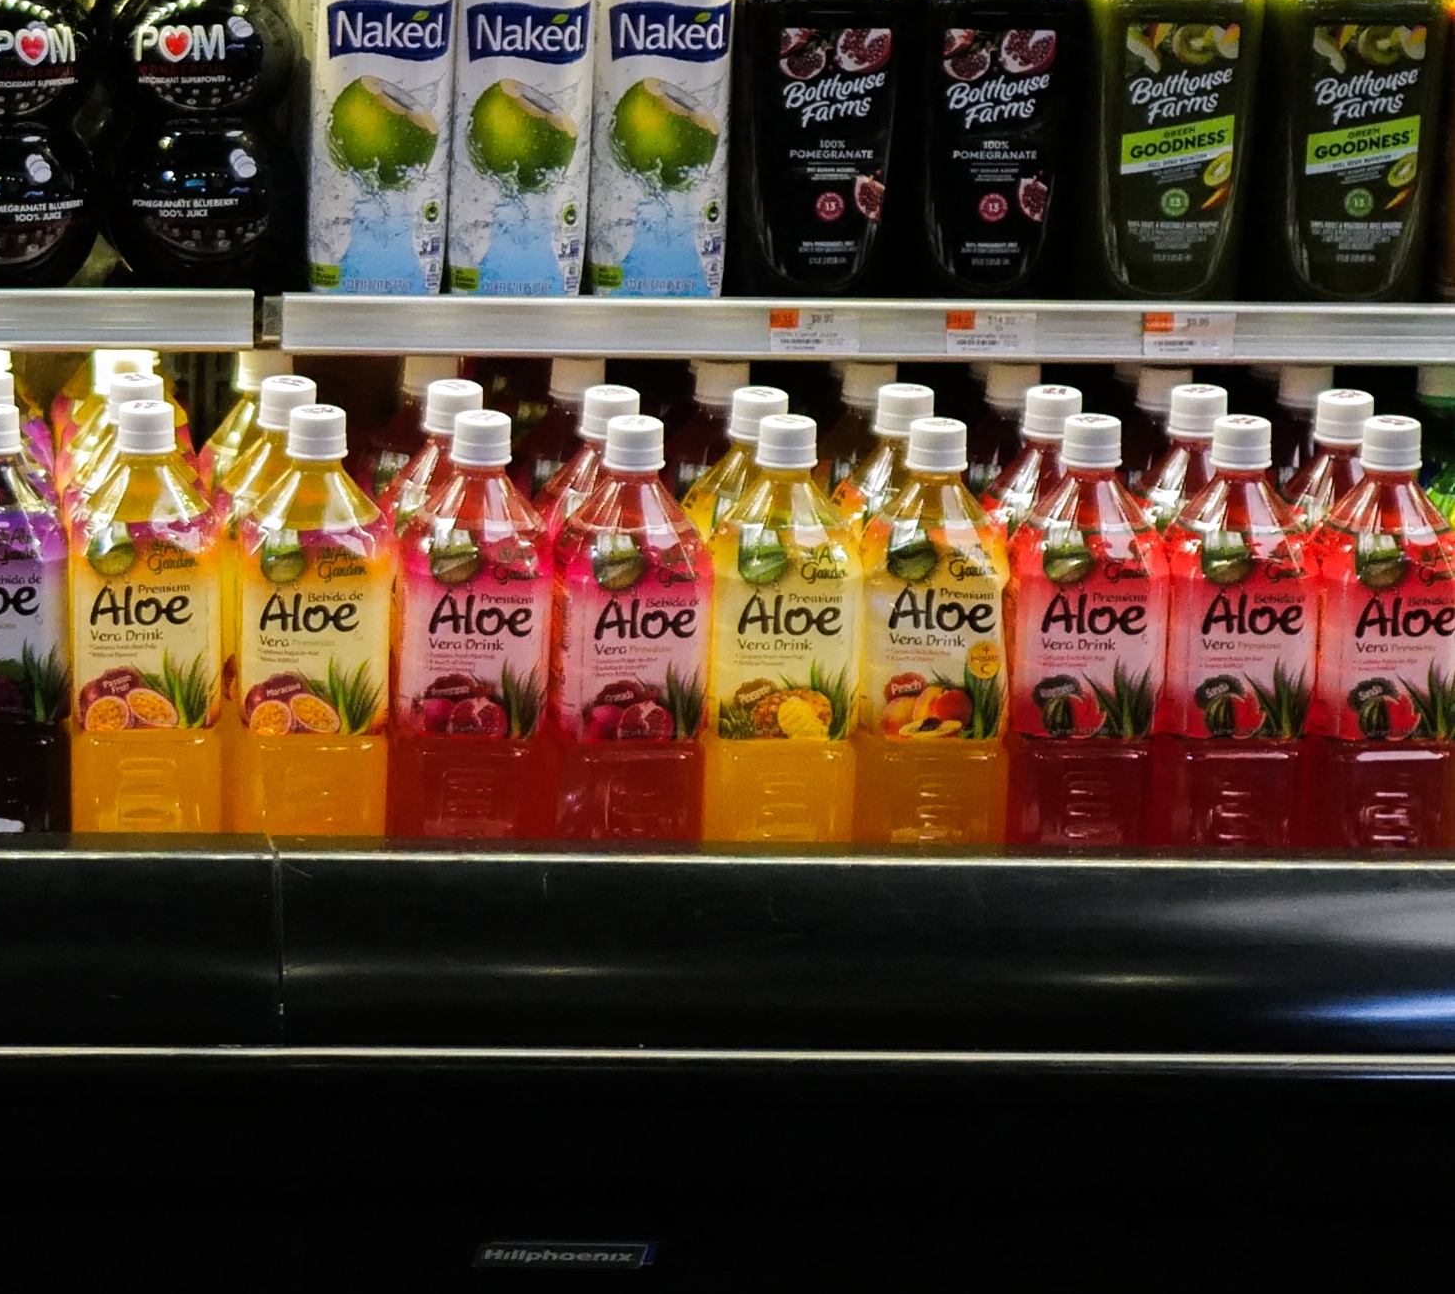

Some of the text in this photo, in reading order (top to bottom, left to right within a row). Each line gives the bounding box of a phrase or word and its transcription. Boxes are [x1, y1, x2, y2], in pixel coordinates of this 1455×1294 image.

[136, 23, 225, 62] POM
[336, 8, 446, 48] Naked
[783, 71, 887, 108] Bolthouse
[1129, 66, 1233, 104] Bolthouse
[801, 96, 871, 128] Farms
[1147, 90, 1218, 124] Farms
[1130, 129, 1226, 160] GOODNESS
[1164, 126, 1196, 139] GREEN
[790, 148, 873, 160] POMEGRANATE
[15, 212, 62, 222] 100% JUICE
[48, 200, 84, 211] BLUEBERRY
[89, 585, 193, 627] Aloe
[259, 591, 360, 633] Aloe
[737, 593, 843, 636] Aloe
[888, 588, 997, 633] Aloe
[1041, 592, 1147, 636] Aloe
[89, 628, 164, 641] Vera Drink
[737, 638, 813, 651] Vera Drink
[891, 679, 923, 695] Peach
[485, 1249, 633, 1263] Hillphoenix
